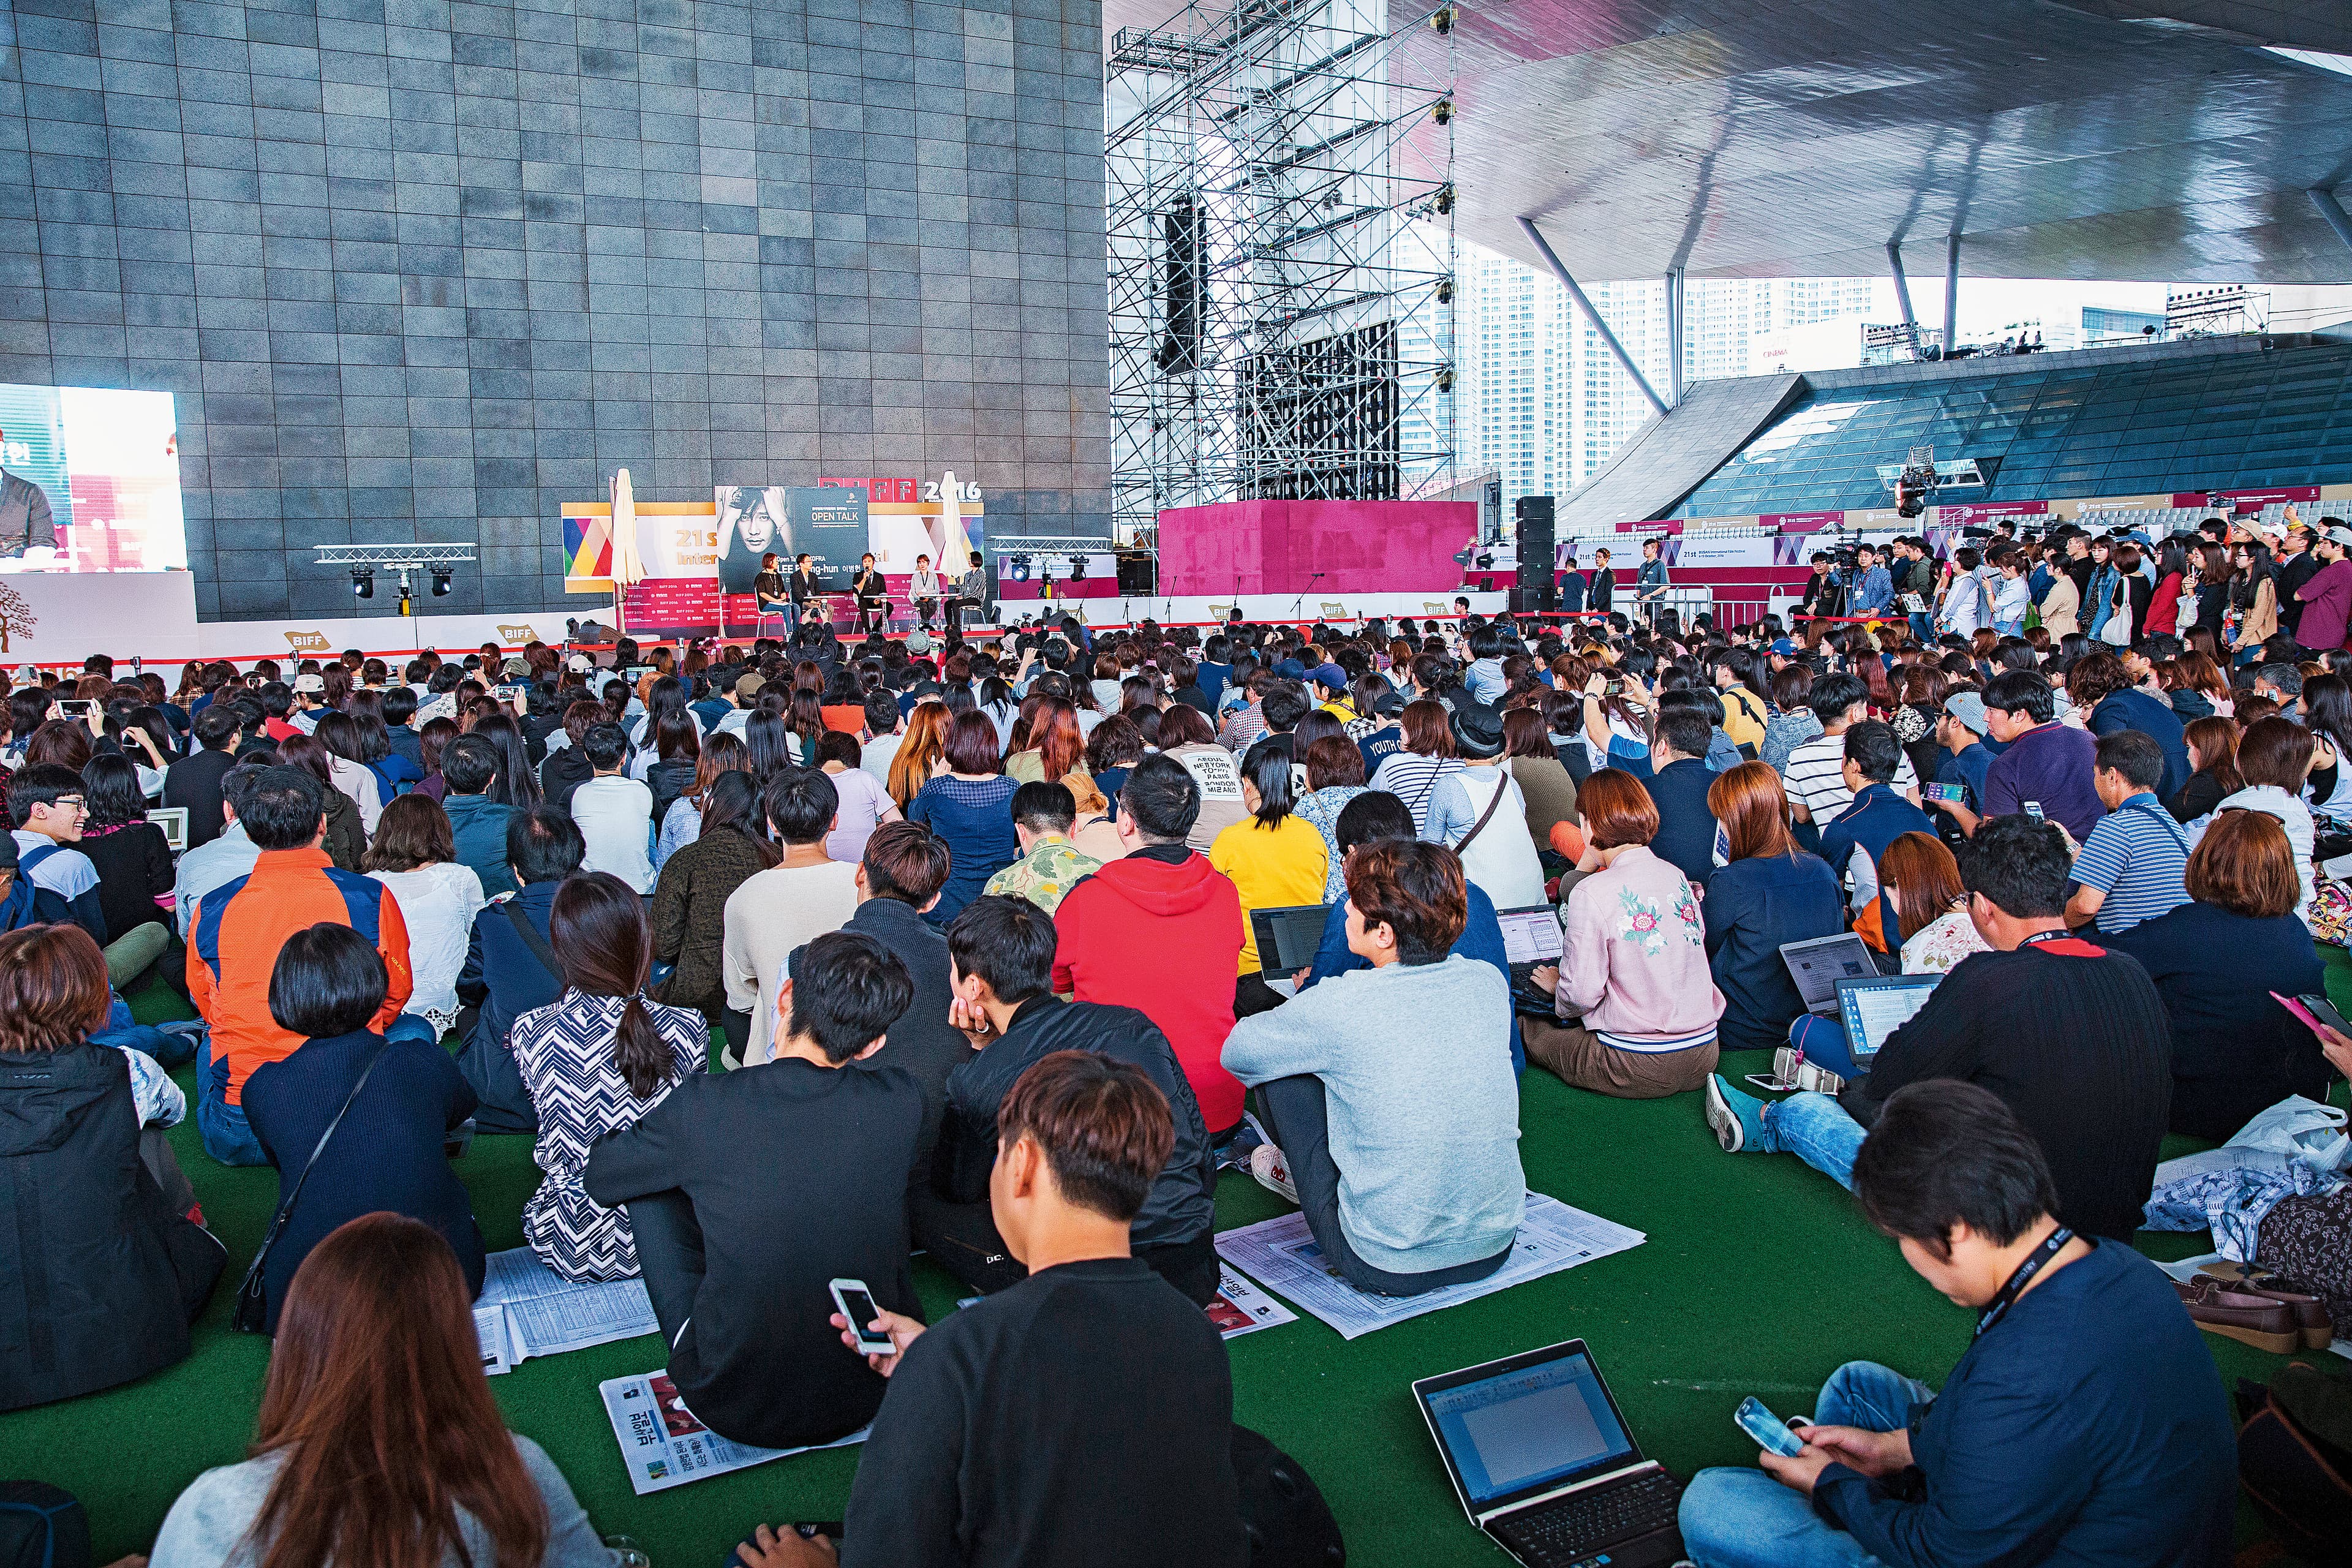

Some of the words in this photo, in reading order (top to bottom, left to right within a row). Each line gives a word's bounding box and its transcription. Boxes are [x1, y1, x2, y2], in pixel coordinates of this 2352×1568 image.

[1763, 349, 1789, 358] CINEMA
[925, 481, 982, 499] 216
[812, 512, 835, 521] OPEN
[836, 511, 859, 521] TALK
[676, 529, 717, 546] 21s
[777, 565, 794, 574] LEE
[795, 564, 839, 575] Bng-hun
[842, 564, 861, 573] 이병헌
[1214, 608, 1231, 617] BIF
[1325, 606, 1343, 615] BIFF
[1428, 606, 1446, 615] BIFF
[505, 629, 532, 639] BIFF
[292, 635, 322, 647] BIFF
[1369, 739, 1397, 756] YOUTH
[628, 1411, 657, 1447] 부산일보
